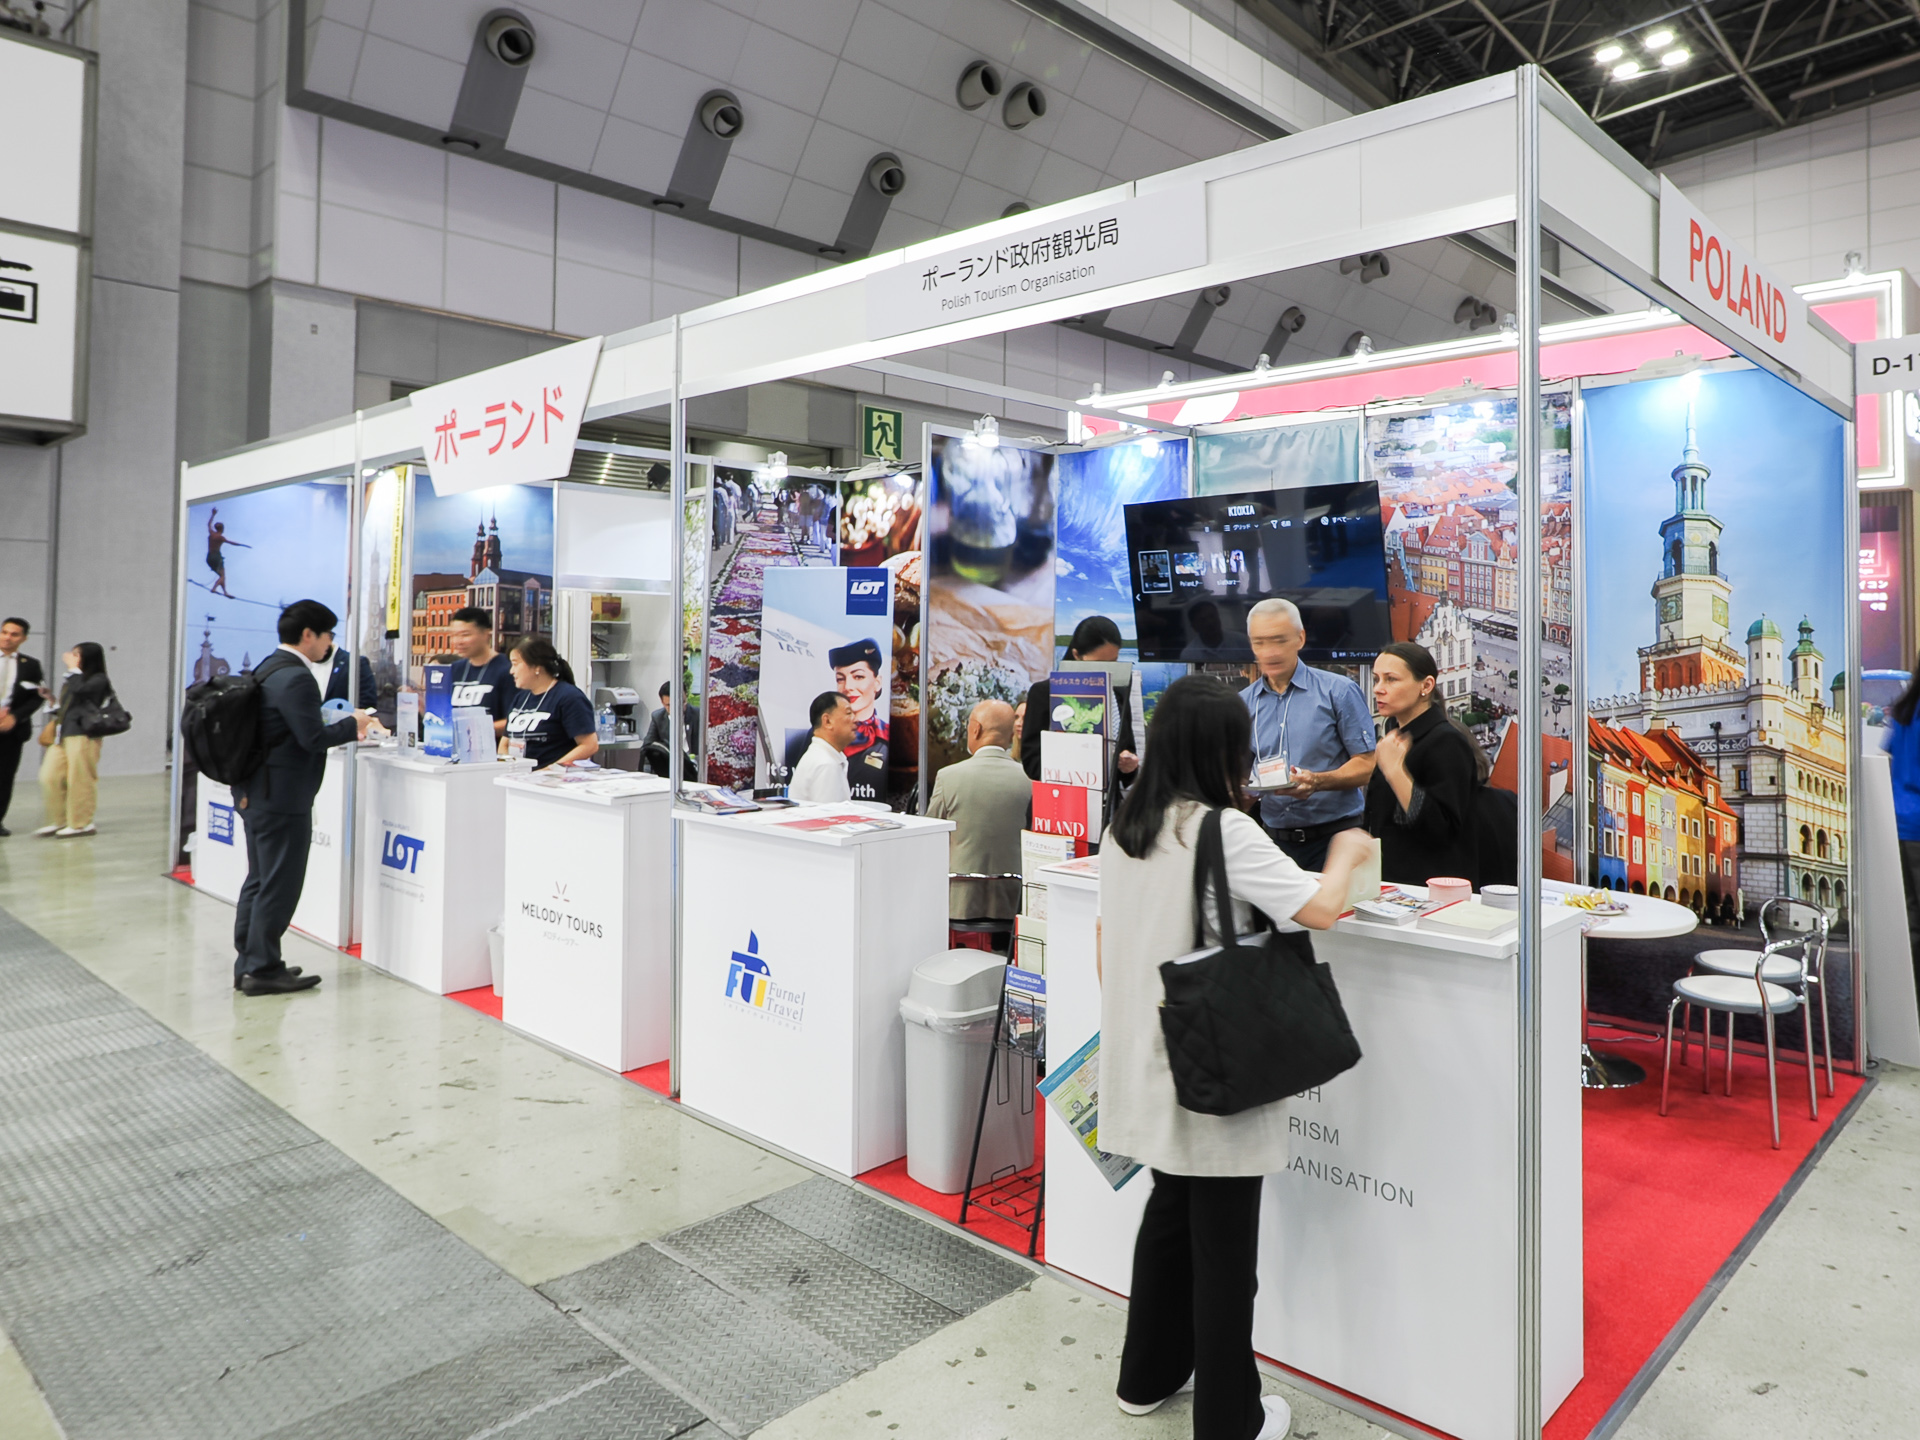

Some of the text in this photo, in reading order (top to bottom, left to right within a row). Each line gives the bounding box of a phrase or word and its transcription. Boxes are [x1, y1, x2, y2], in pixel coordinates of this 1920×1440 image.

[922, 217, 1119, 292] ポーランド政府観光局
[941, 264, 1096, 311] Polish Tourism Organisation
[1689, 217, 1787, 344] POLAND
[1872, 353, 1920, 376] D-1
[434, 384, 565, 465] ポーランド
[1227, 504, 1256, 517] KIOXIA
[850, 581, 885, 595] LOT
[451, 684, 494, 706] LOT
[507, 711, 552, 733] LOT
[766, 761, 789, 777] It's
[1034, 817, 1085, 838] POLAND
[381, 830, 425, 874] LOT
[521, 901, 603, 939] MELODY TOURS
[768, 981, 806, 1006] Furnel
[767, 996, 804, 1022] Travel
[1287, 1156, 1413, 1208] ANISATION
